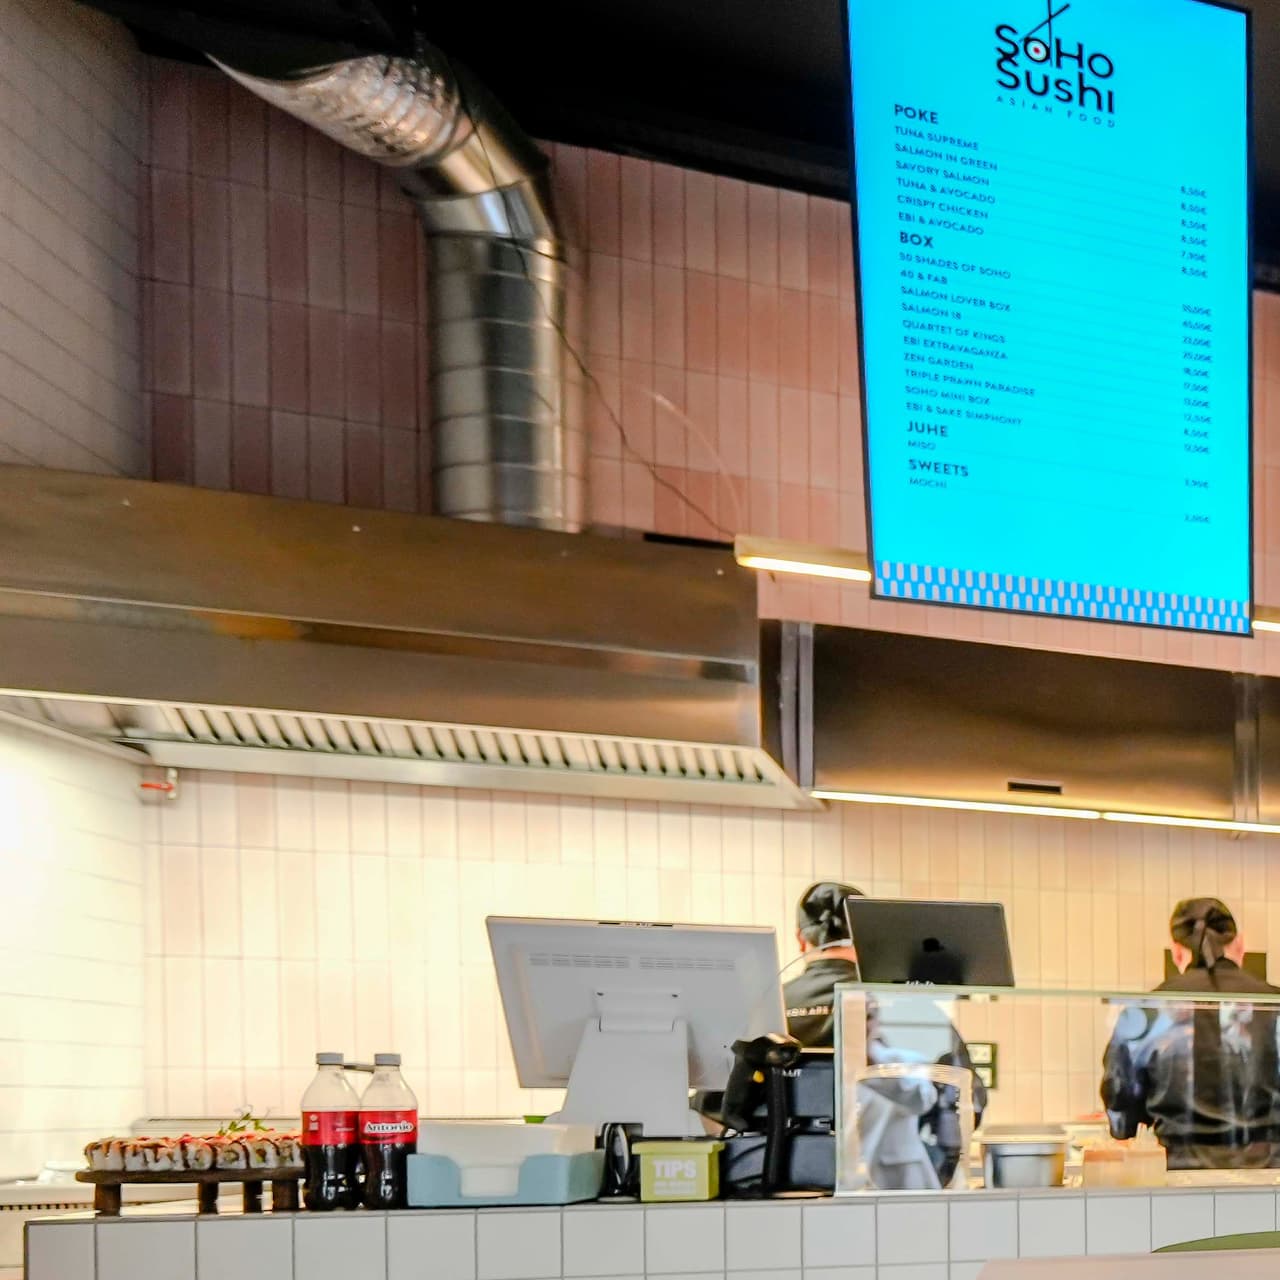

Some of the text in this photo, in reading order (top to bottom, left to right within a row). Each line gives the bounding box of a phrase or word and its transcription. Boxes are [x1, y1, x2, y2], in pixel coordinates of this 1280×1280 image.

[893, 103, 938, 124] POKE
[996, 95, 1117, 128] ASIAN FOOD
[894, 125, 978, 150] TUNA SUPREME
[894, 142, 997, 170] SALMON IN GREEN
[895, 160, 989, 185] SAVORY SALMON
[897, 177, 926, 190] TUNA
[939, 187, 995, 203] AVOCADO
[896, 194, 988, 218] CRISPY CHICKEN
[897, 211, 915, 222] EBI
[928, 218, 984, 235] AVOCADO
[899, 230, 933, 248] BOX
[900, 285, 1010, 311] SALMON LOVER BOX
[904, 352, 973, 369] ZEN GARDEN
[905, 368, 1034, 395] TRIPLE PRAWN PARADISE
[907, 420, 947, 437] JUHE
[908, 458, 968, 477] SWEETS
[909, 477, 946, 487] MOCHI
[365, 1120, 414, 1133] Antonio
[653, 1159, 697, 1179] TIPS
